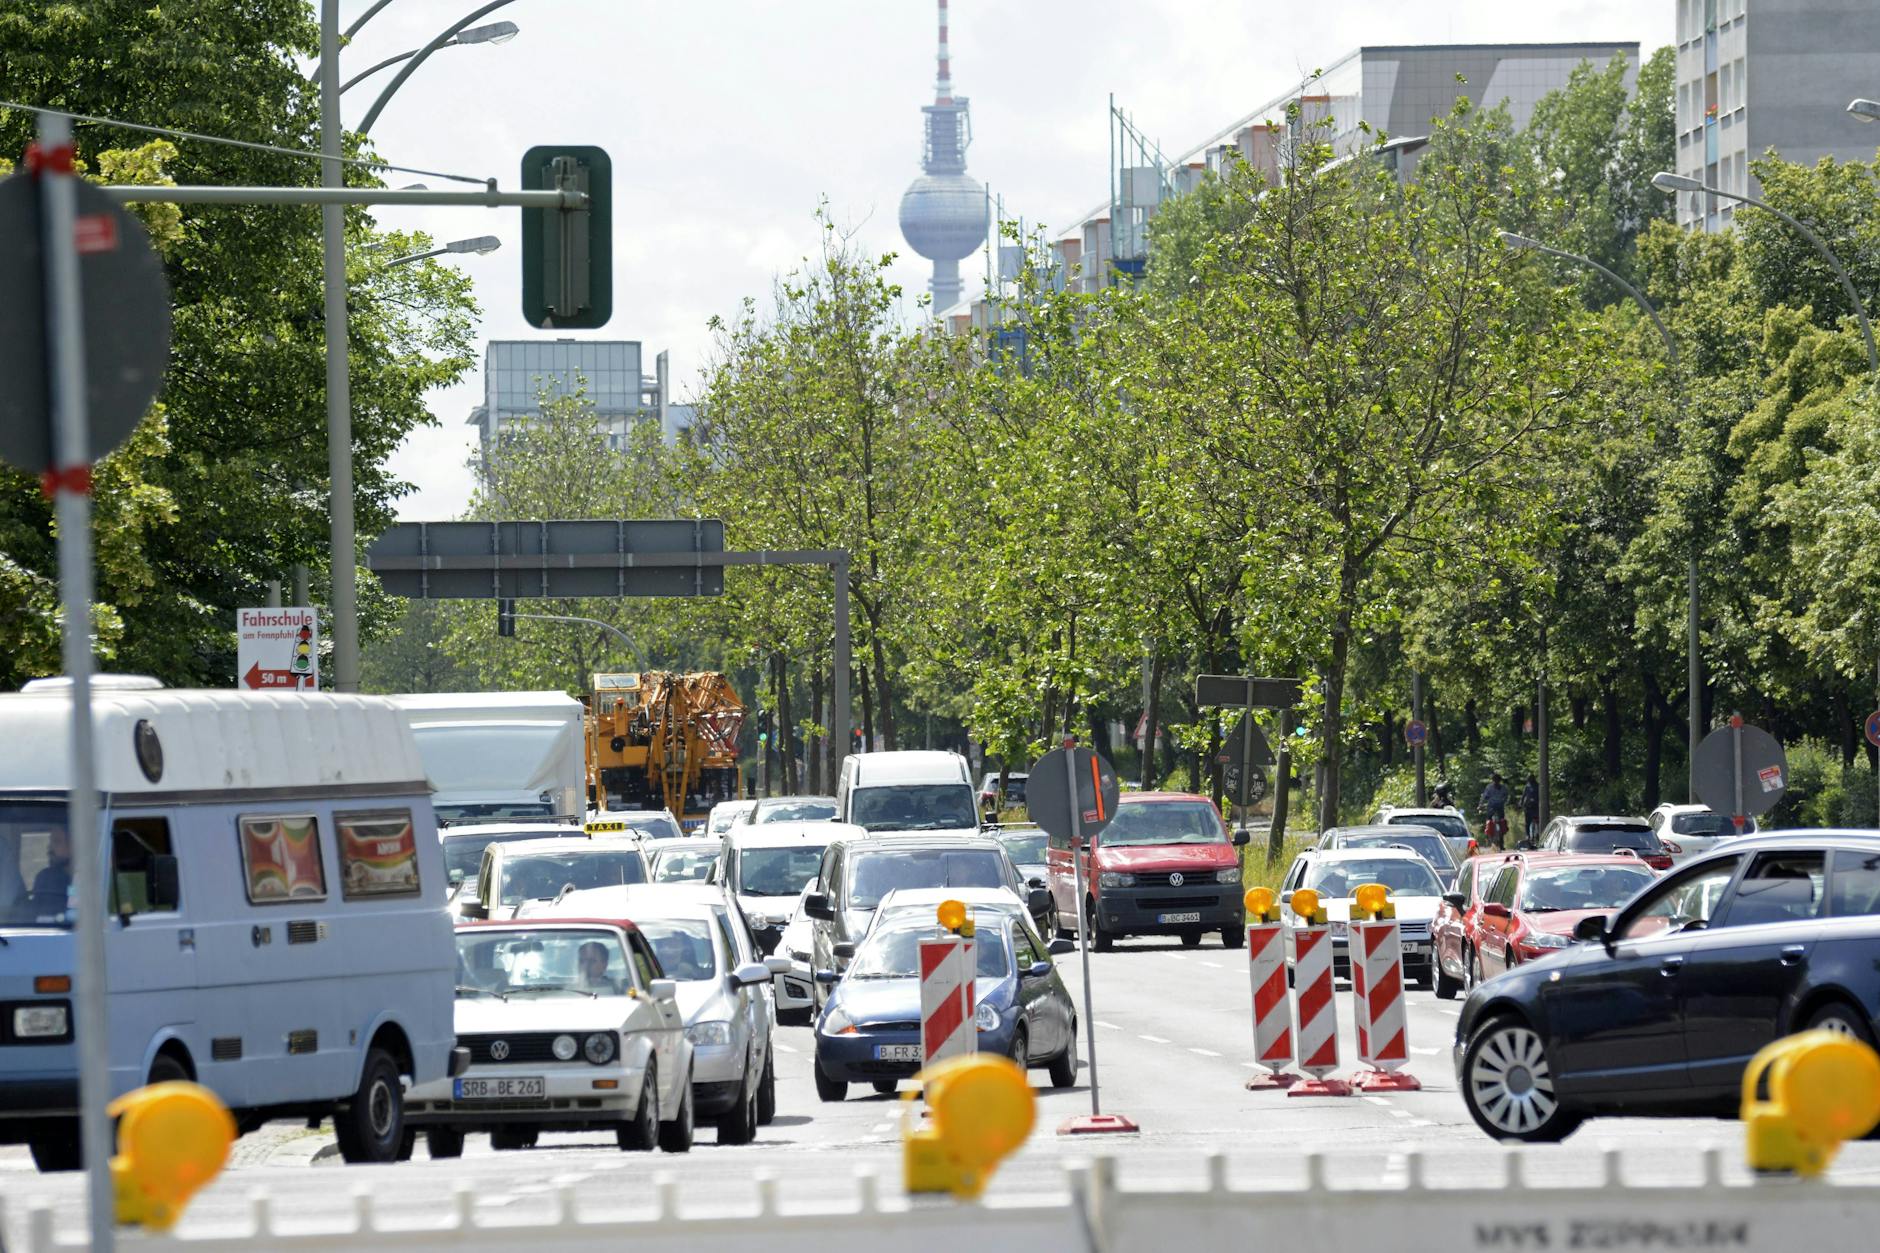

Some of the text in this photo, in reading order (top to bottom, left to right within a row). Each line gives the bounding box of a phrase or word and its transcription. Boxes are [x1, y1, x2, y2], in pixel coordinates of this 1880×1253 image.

[242, 610, 313, 627] Fahrschule
[261, 673, 287, 684] 50 m
[591, 823, 617, 832] TAXI
[880, 1047, 888, 1058] B
[894, 1047, 909, 1058] FR
[463, 1080, 542, 1096] SRB BE 261
